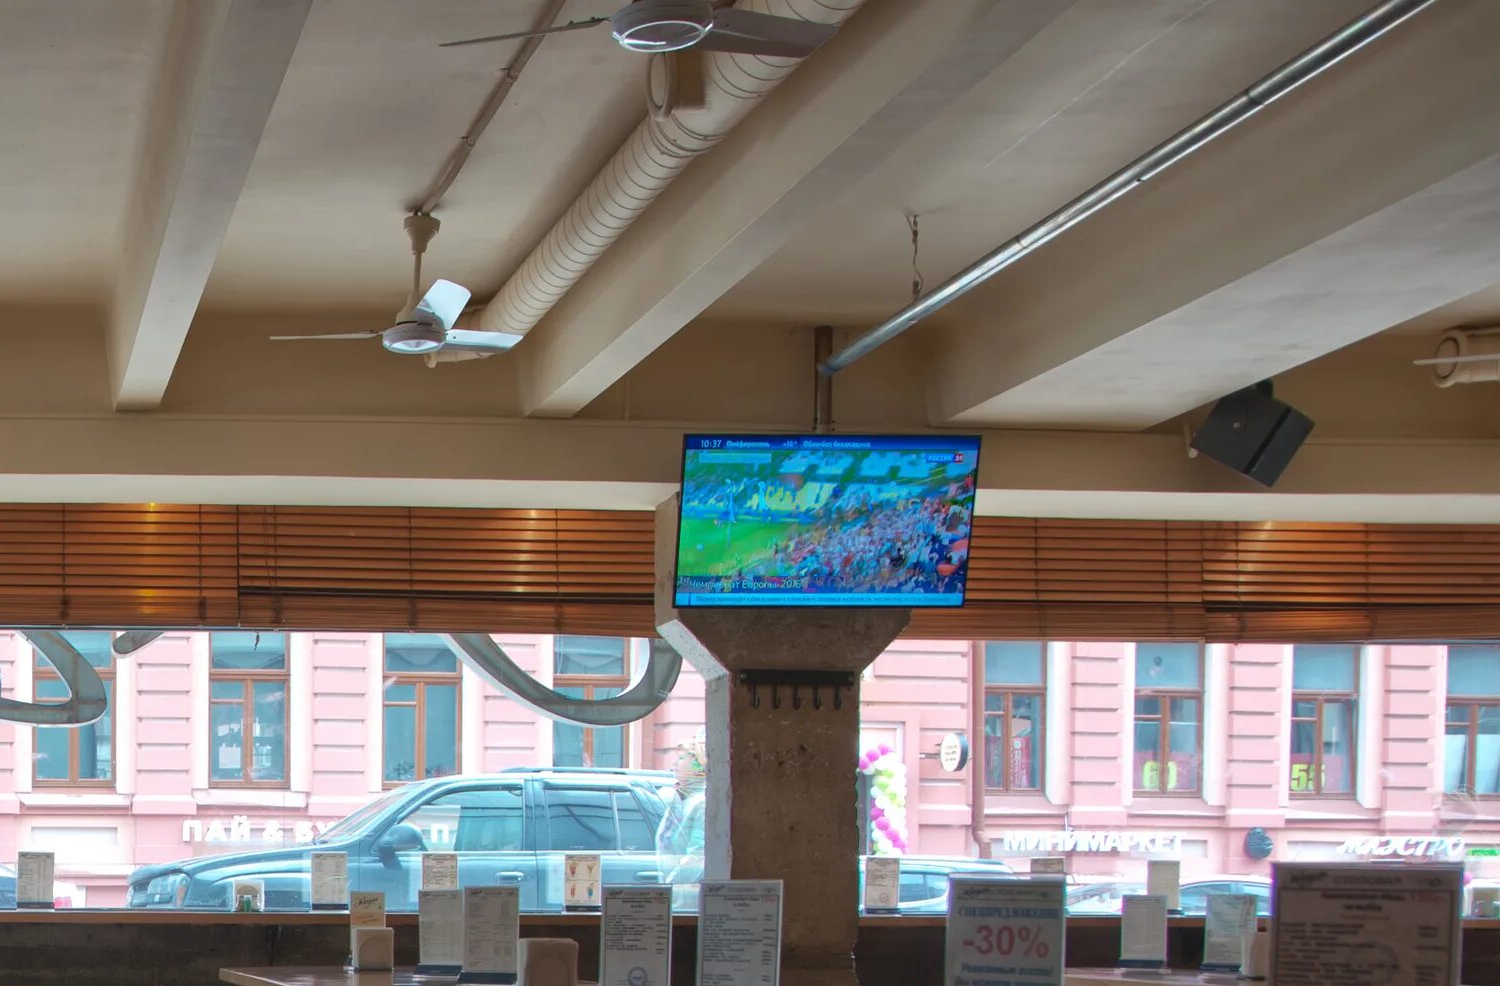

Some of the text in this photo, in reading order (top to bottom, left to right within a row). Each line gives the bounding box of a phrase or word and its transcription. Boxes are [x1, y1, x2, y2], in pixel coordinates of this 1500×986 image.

[701, 439, 722, 448] 10:37
[182, 815, 251, 842] ПАЙ
[263, 819, 283, 843] &
[1003, 830, 1186, 851] МИНИМАРКЕТ
[963, 924, 1050, 958] -30%
